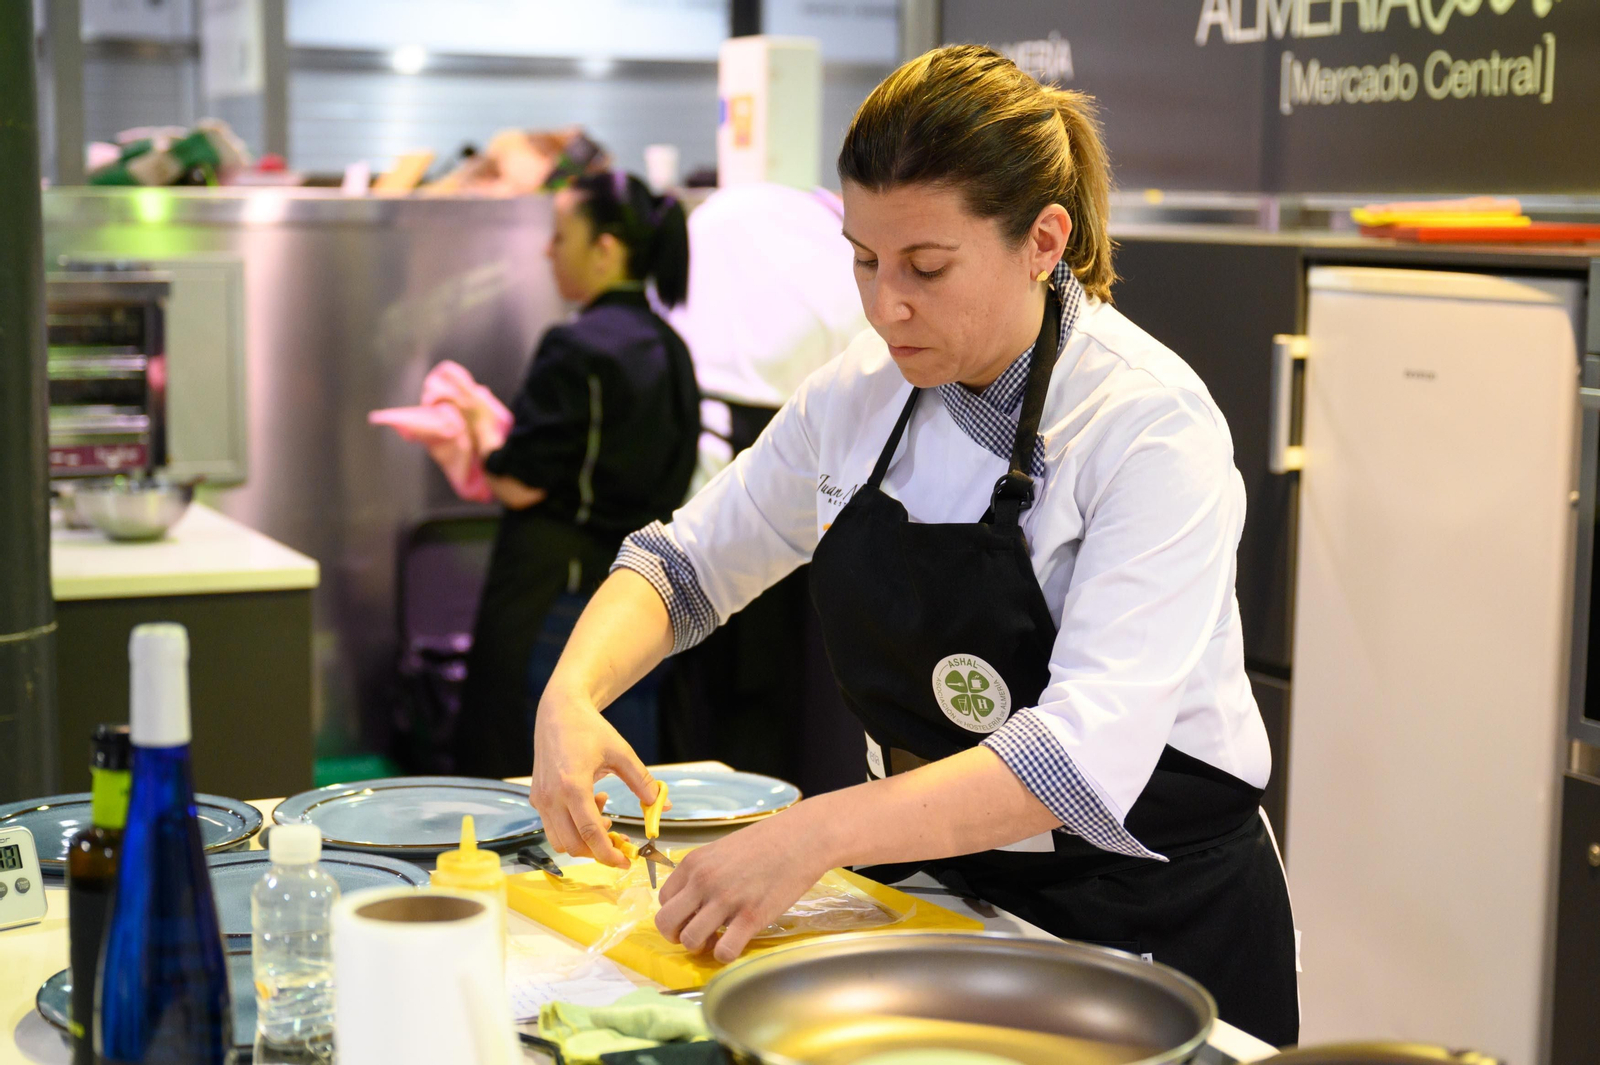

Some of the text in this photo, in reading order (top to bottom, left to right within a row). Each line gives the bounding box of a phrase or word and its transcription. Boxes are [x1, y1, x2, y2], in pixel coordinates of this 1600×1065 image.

[817, 474, 843, 497] Juan
[948, 658, 978, 668] ASHAL
[936, 677, 956, 719] ASOCIACIÓN
[964, 717, 1002, 730] HOSTELERÍA
[993, 679, 1007, 709] ALMERÍA
